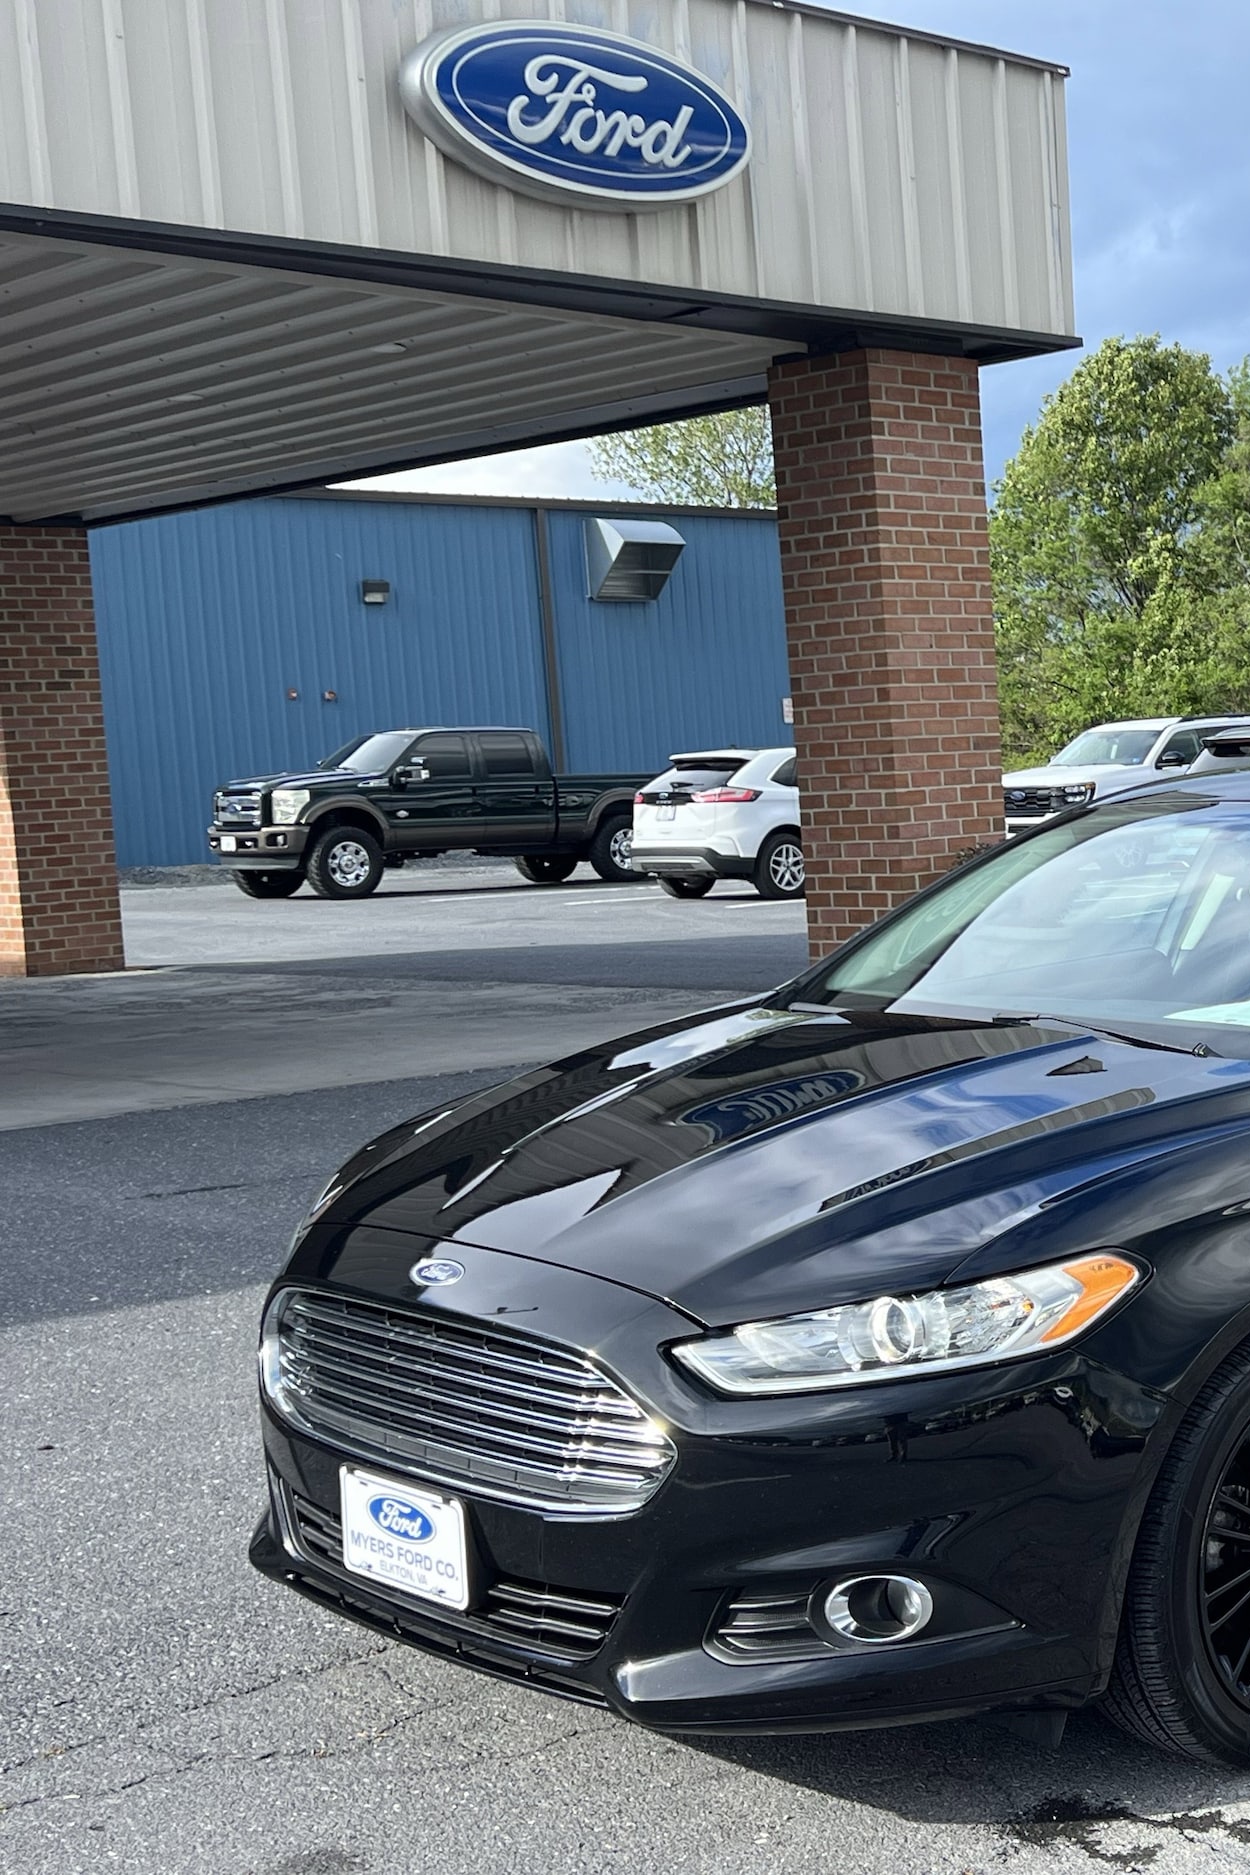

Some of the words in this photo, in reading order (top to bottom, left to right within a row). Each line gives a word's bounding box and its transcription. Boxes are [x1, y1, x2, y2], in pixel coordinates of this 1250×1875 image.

[507, 54, 694, 168] Ford
[379, 1500, 422, 1538] Ford
[350, 1529, 394, 1559] MYERS
[397, 1546, 433, 1572] FORD
[435, 1559, 459, 1581] CO.
